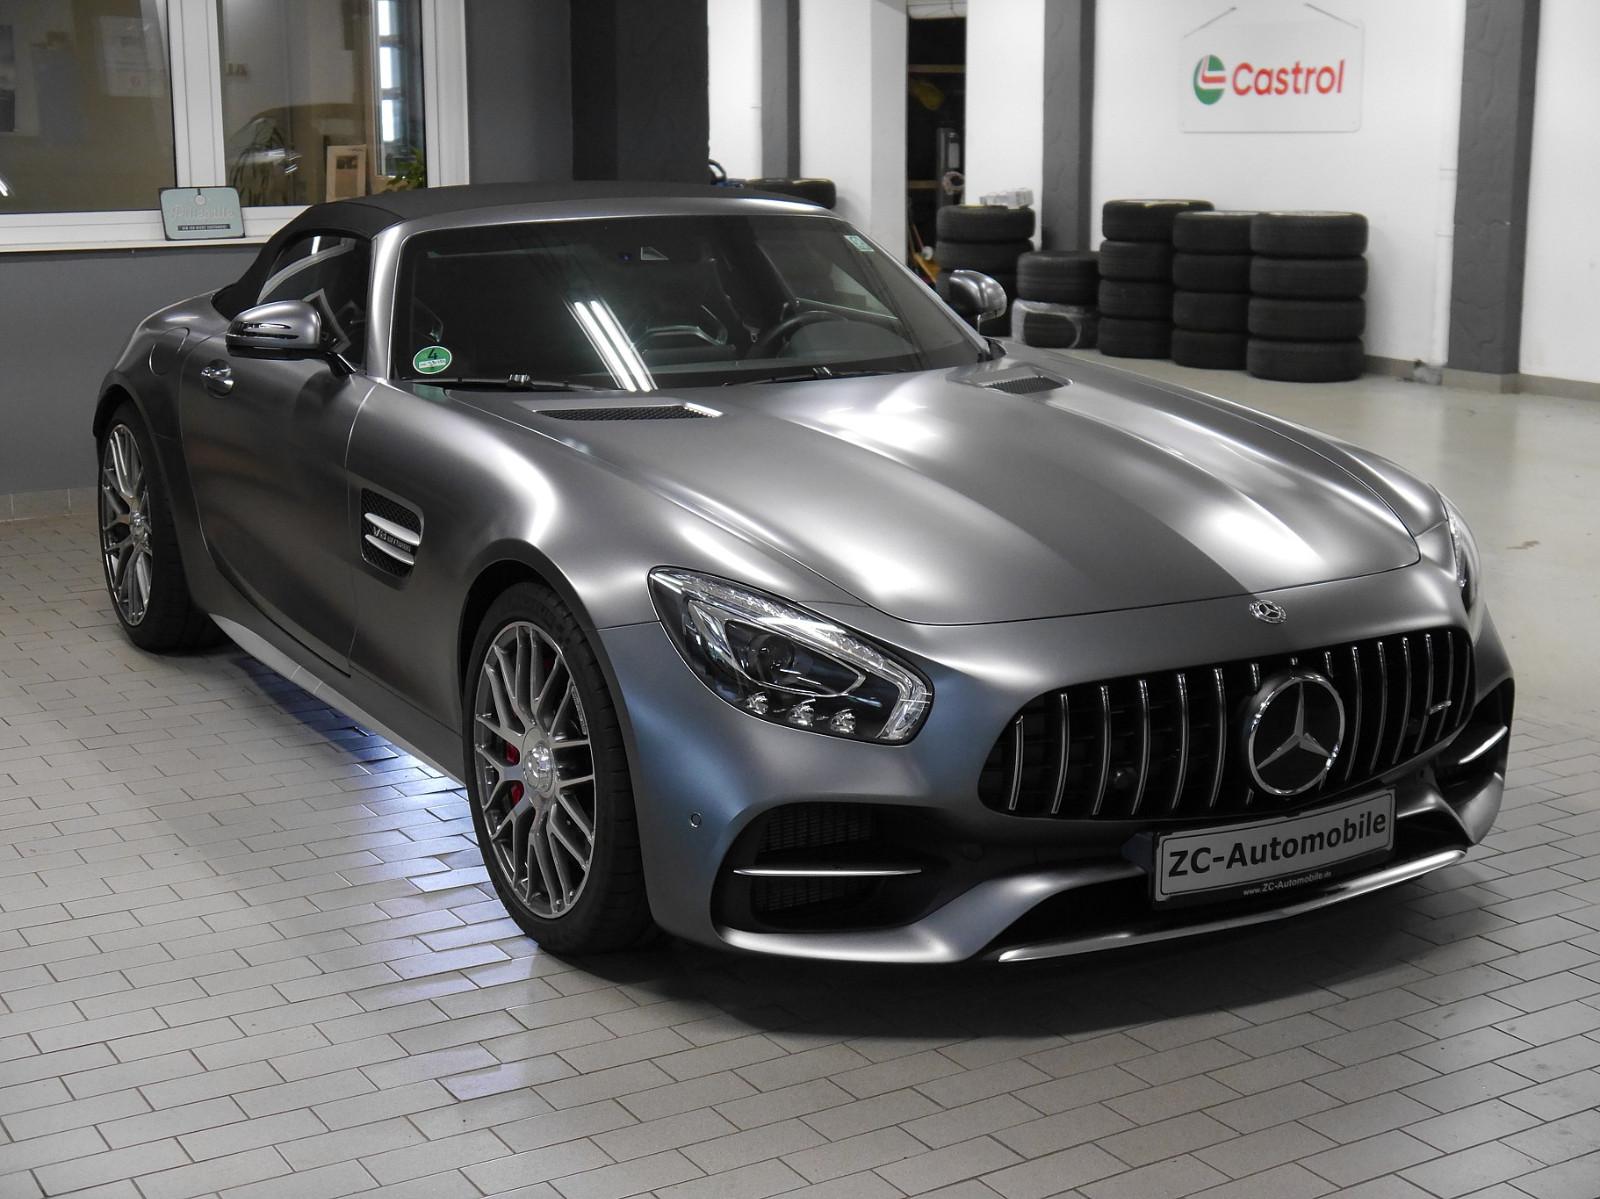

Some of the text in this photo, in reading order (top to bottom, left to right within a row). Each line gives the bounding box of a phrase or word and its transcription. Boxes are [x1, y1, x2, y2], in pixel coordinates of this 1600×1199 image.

[1232, 59, 1345, 96] Castrol
[428, 348, 438, 360] 4
[1168, 811, 1387, 878] ZC-Automobile
[1243, 870, 1332, 896] www.ZC-Automobile.de
